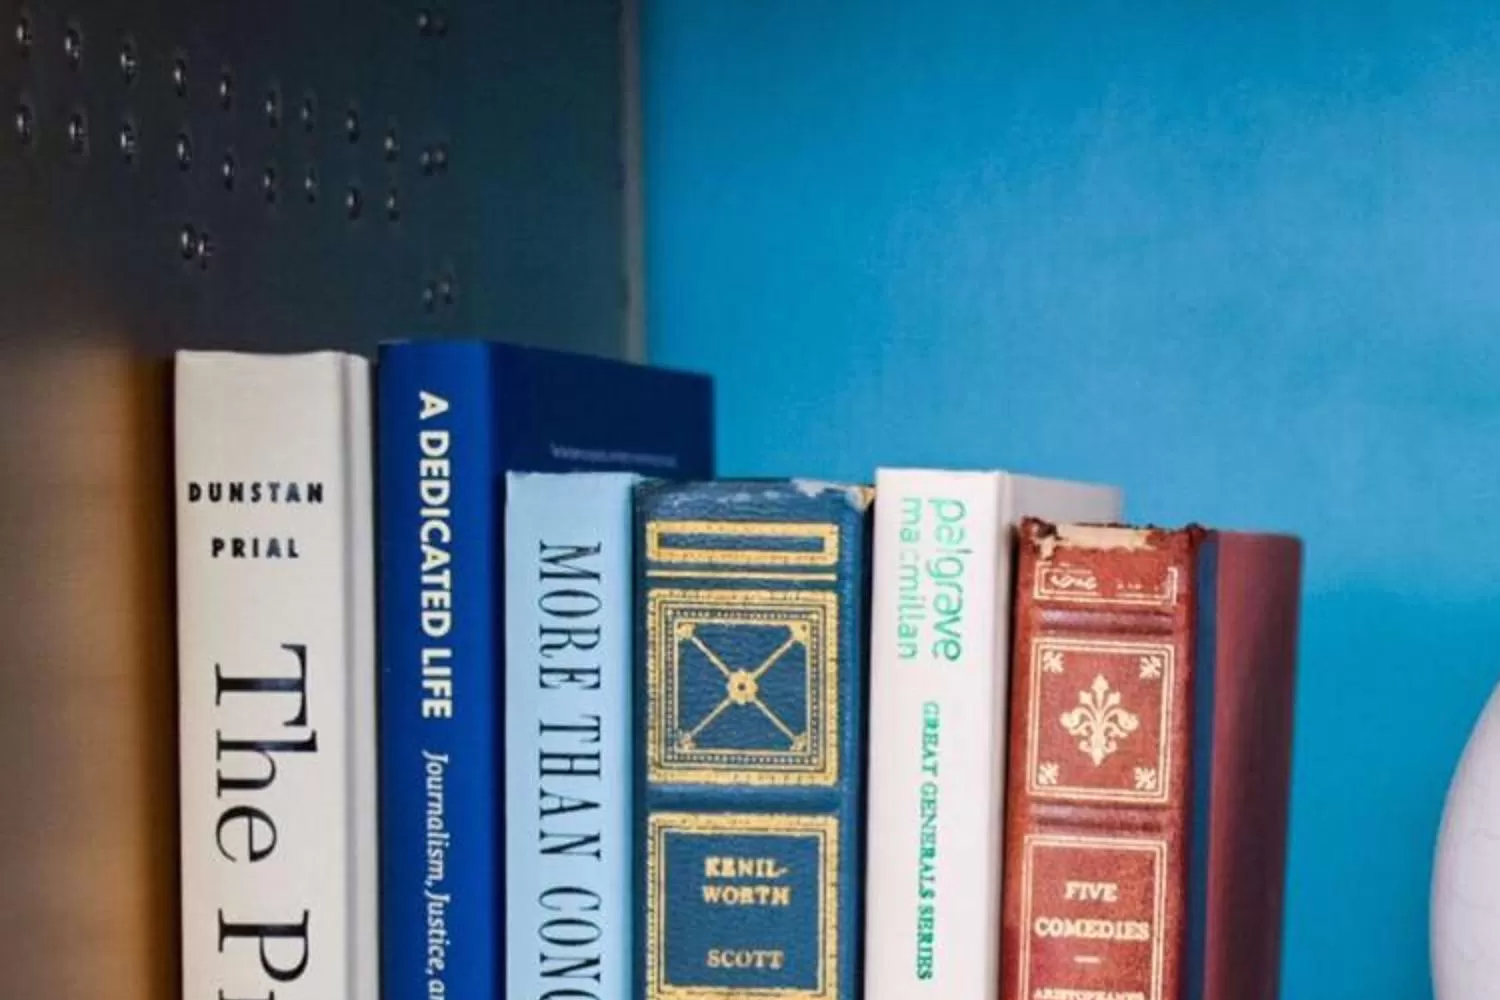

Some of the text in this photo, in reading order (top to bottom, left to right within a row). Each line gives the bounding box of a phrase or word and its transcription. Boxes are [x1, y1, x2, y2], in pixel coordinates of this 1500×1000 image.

[188, 481, 323, 504] DUNSTAN
[211, 537, 299, 559] PRIAL
[419, 390, 453, 719] A DEDICATED LIFE
[896, 497, 927, 661] macmillan
[925, 498, 973, 663] palgrave
[538, 540, 602, 690] MORE
[214, 643, 318, 863] The
[538, 715, 601, 860] THAN
[421, 749, 451, 888] Journalism,
[704, 855, 788, 879] KENIL-
[916, 701, 940, 981] GREAT GENERALS SERIES
[423, 889, 451, 975] Justice,
[701, 884, 791, 906] WORTH
[1034, 916, 1150, 941] COMEDIES
[1063, 880, 1119, 903] FIVE
[706, 949, 784, 970] SCOTT
